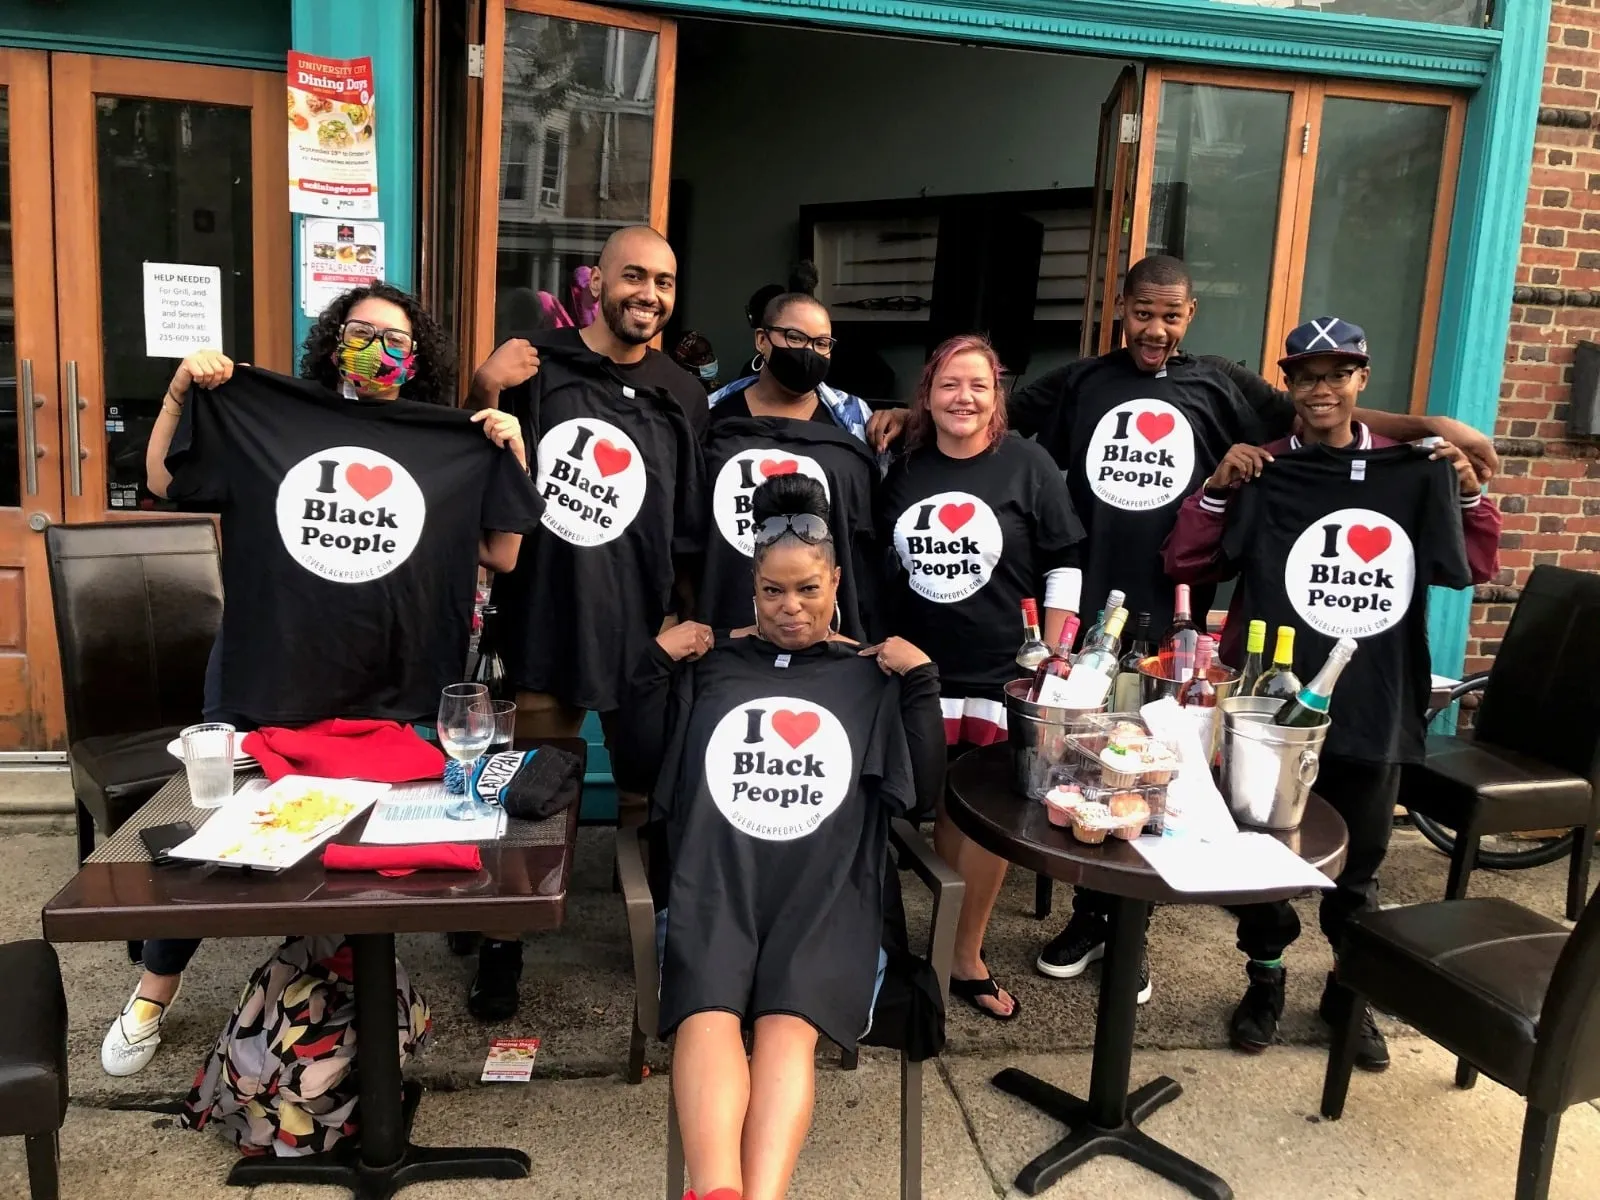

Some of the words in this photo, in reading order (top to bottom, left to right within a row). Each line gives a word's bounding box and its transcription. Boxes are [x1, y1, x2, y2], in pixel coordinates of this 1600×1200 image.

[298, 59, 352, 75] UNIVERSITY
[298, 72, 344, 93] Dining
[346, 78, 368, 92] Days
[154, 274, 175, 282] HELP
[177, 275, 211, 284] NEEDED
[1112, 411, 1133, 440] I
[567, 425, 594, 460] I
[1102, 445, 1175, 468] Black
[316, 460, 340, 493] I
[549, 458, 620, 508] Black
[736, 459, 757, 489] I
[1098, 466, 1174, 488] People
[302, 498, 399, 528] Black
[542, 481, 613, 528] People
[913, 504, 937, 530] I
[300, 526, 396, 555] People
[906, 536, 981, 554] Black
[1320, 523, 1343, 558] I
[911, 559, 982, 579] People
[1308, 563, 1395, 589] Black
[1307, 588, 1393, 613] People
[743, 708, 767, 744] I
[732, 751, 826, 778] Black
[731, 781, 824, 809] People
